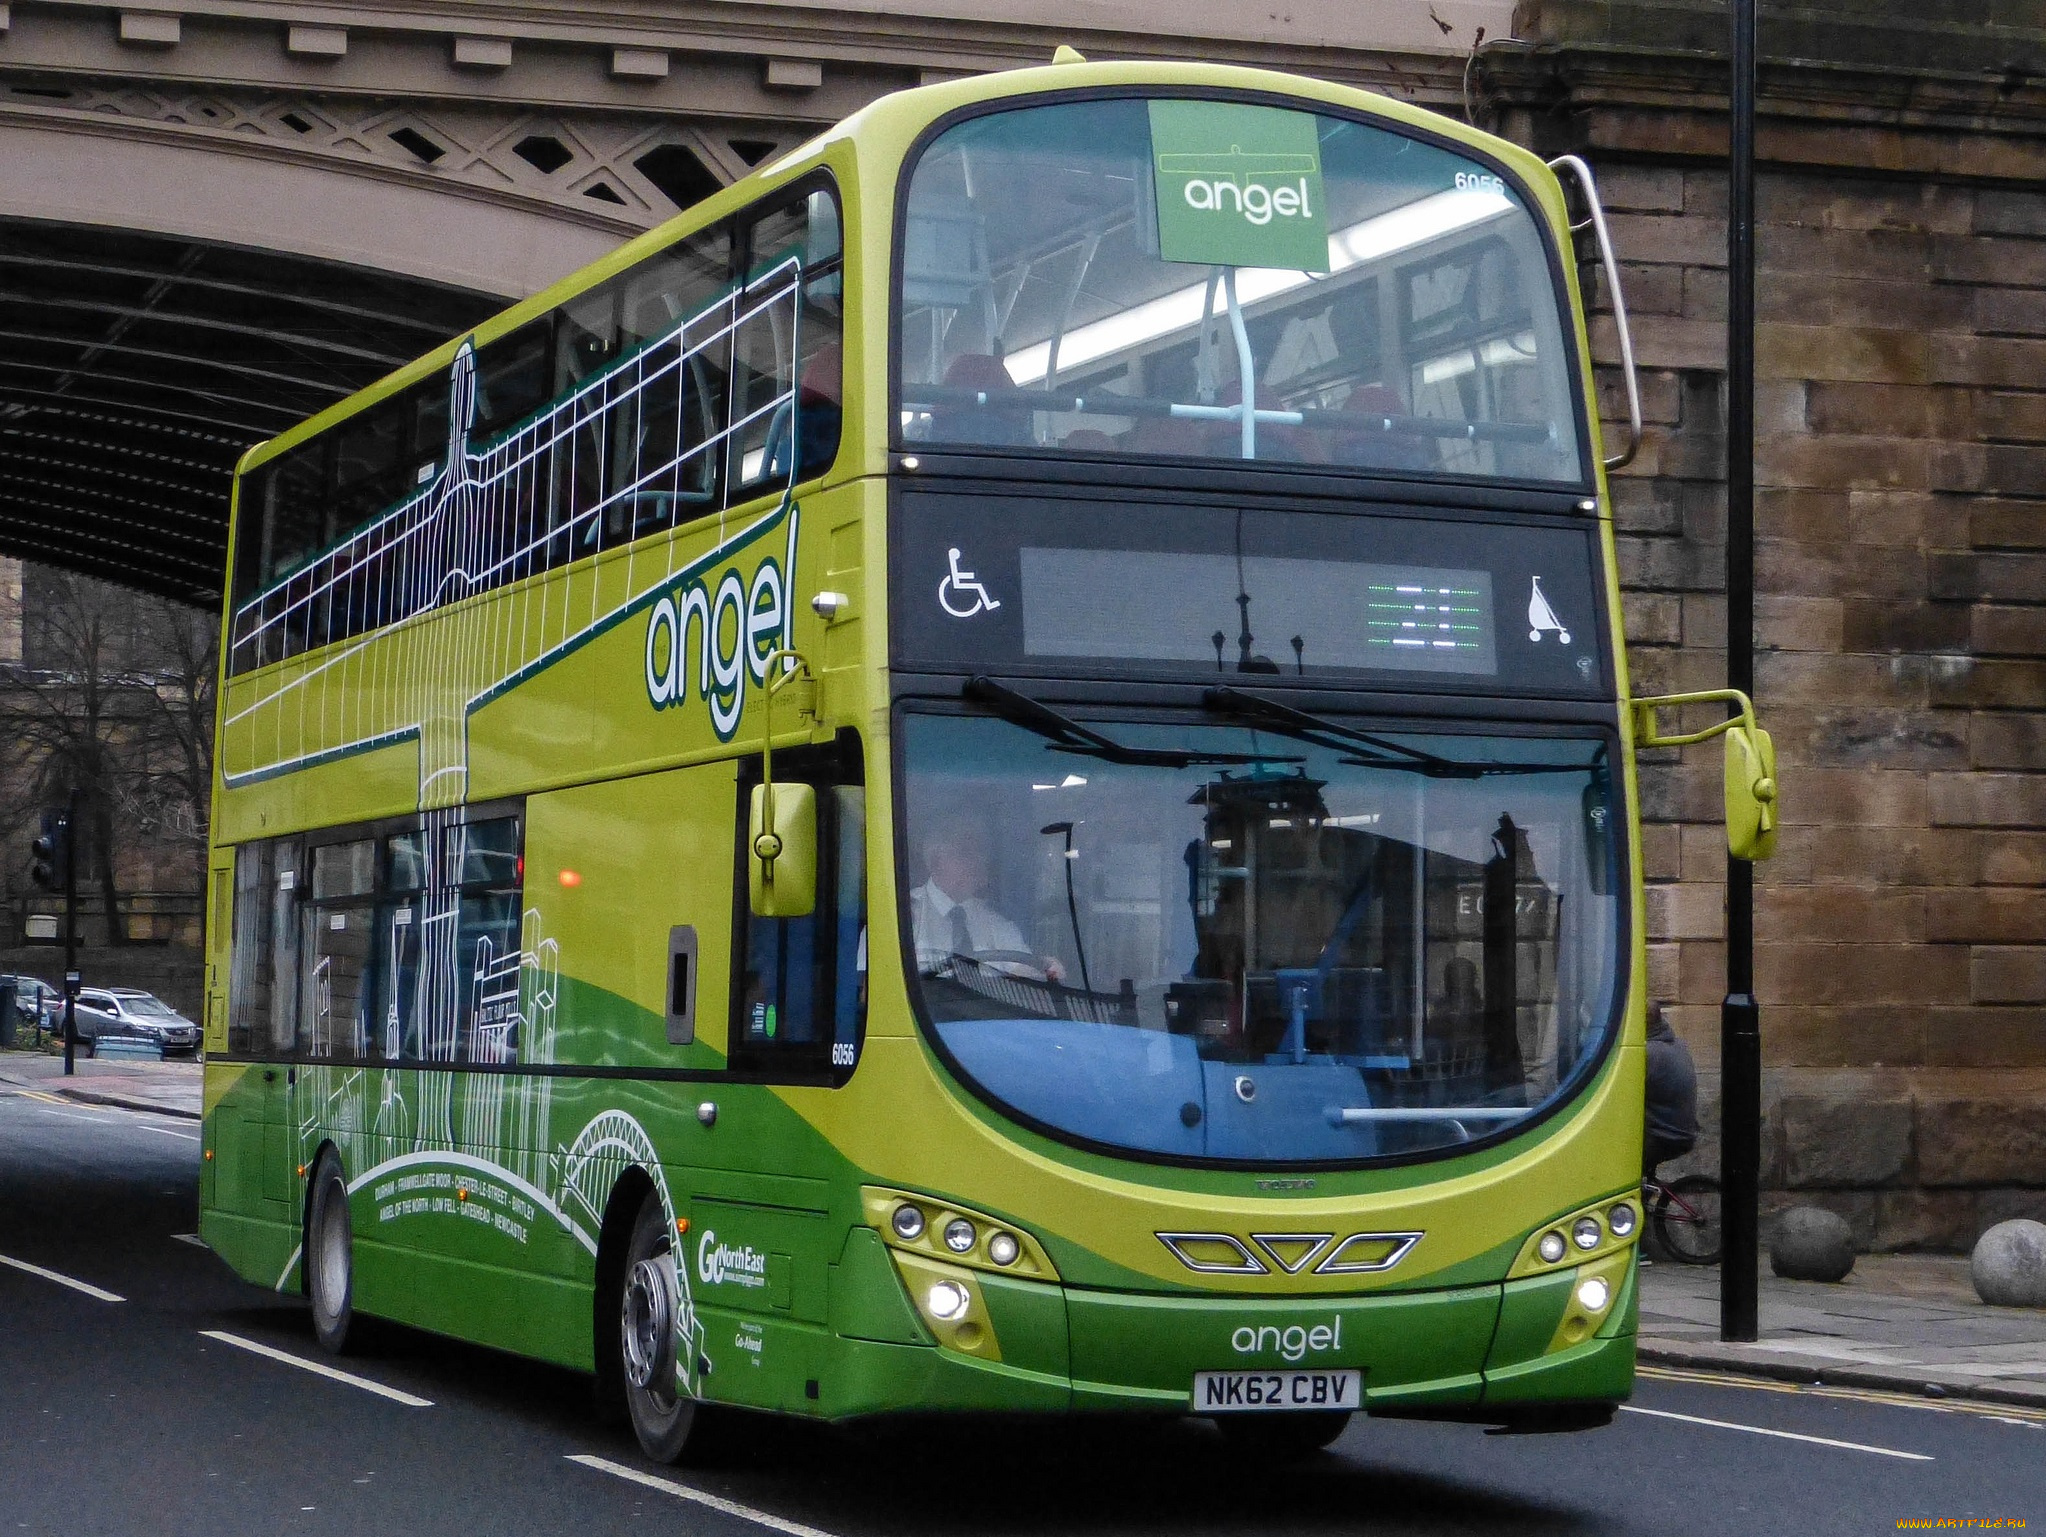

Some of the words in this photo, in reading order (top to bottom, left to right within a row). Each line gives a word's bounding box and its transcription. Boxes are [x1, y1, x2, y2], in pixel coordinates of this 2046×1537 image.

[1184, 178, 1312, 225] angel
[1455, 172, 1504, 195] 6056
[646, 506, 799, 736] angel
[832, 1043, 854, 1065] 6056
[1232, 1314, 1341, 1361] angel
[1207, 1375, 1283, 1405] NK62
[1292, 1375, 1347, 1404] CBV
